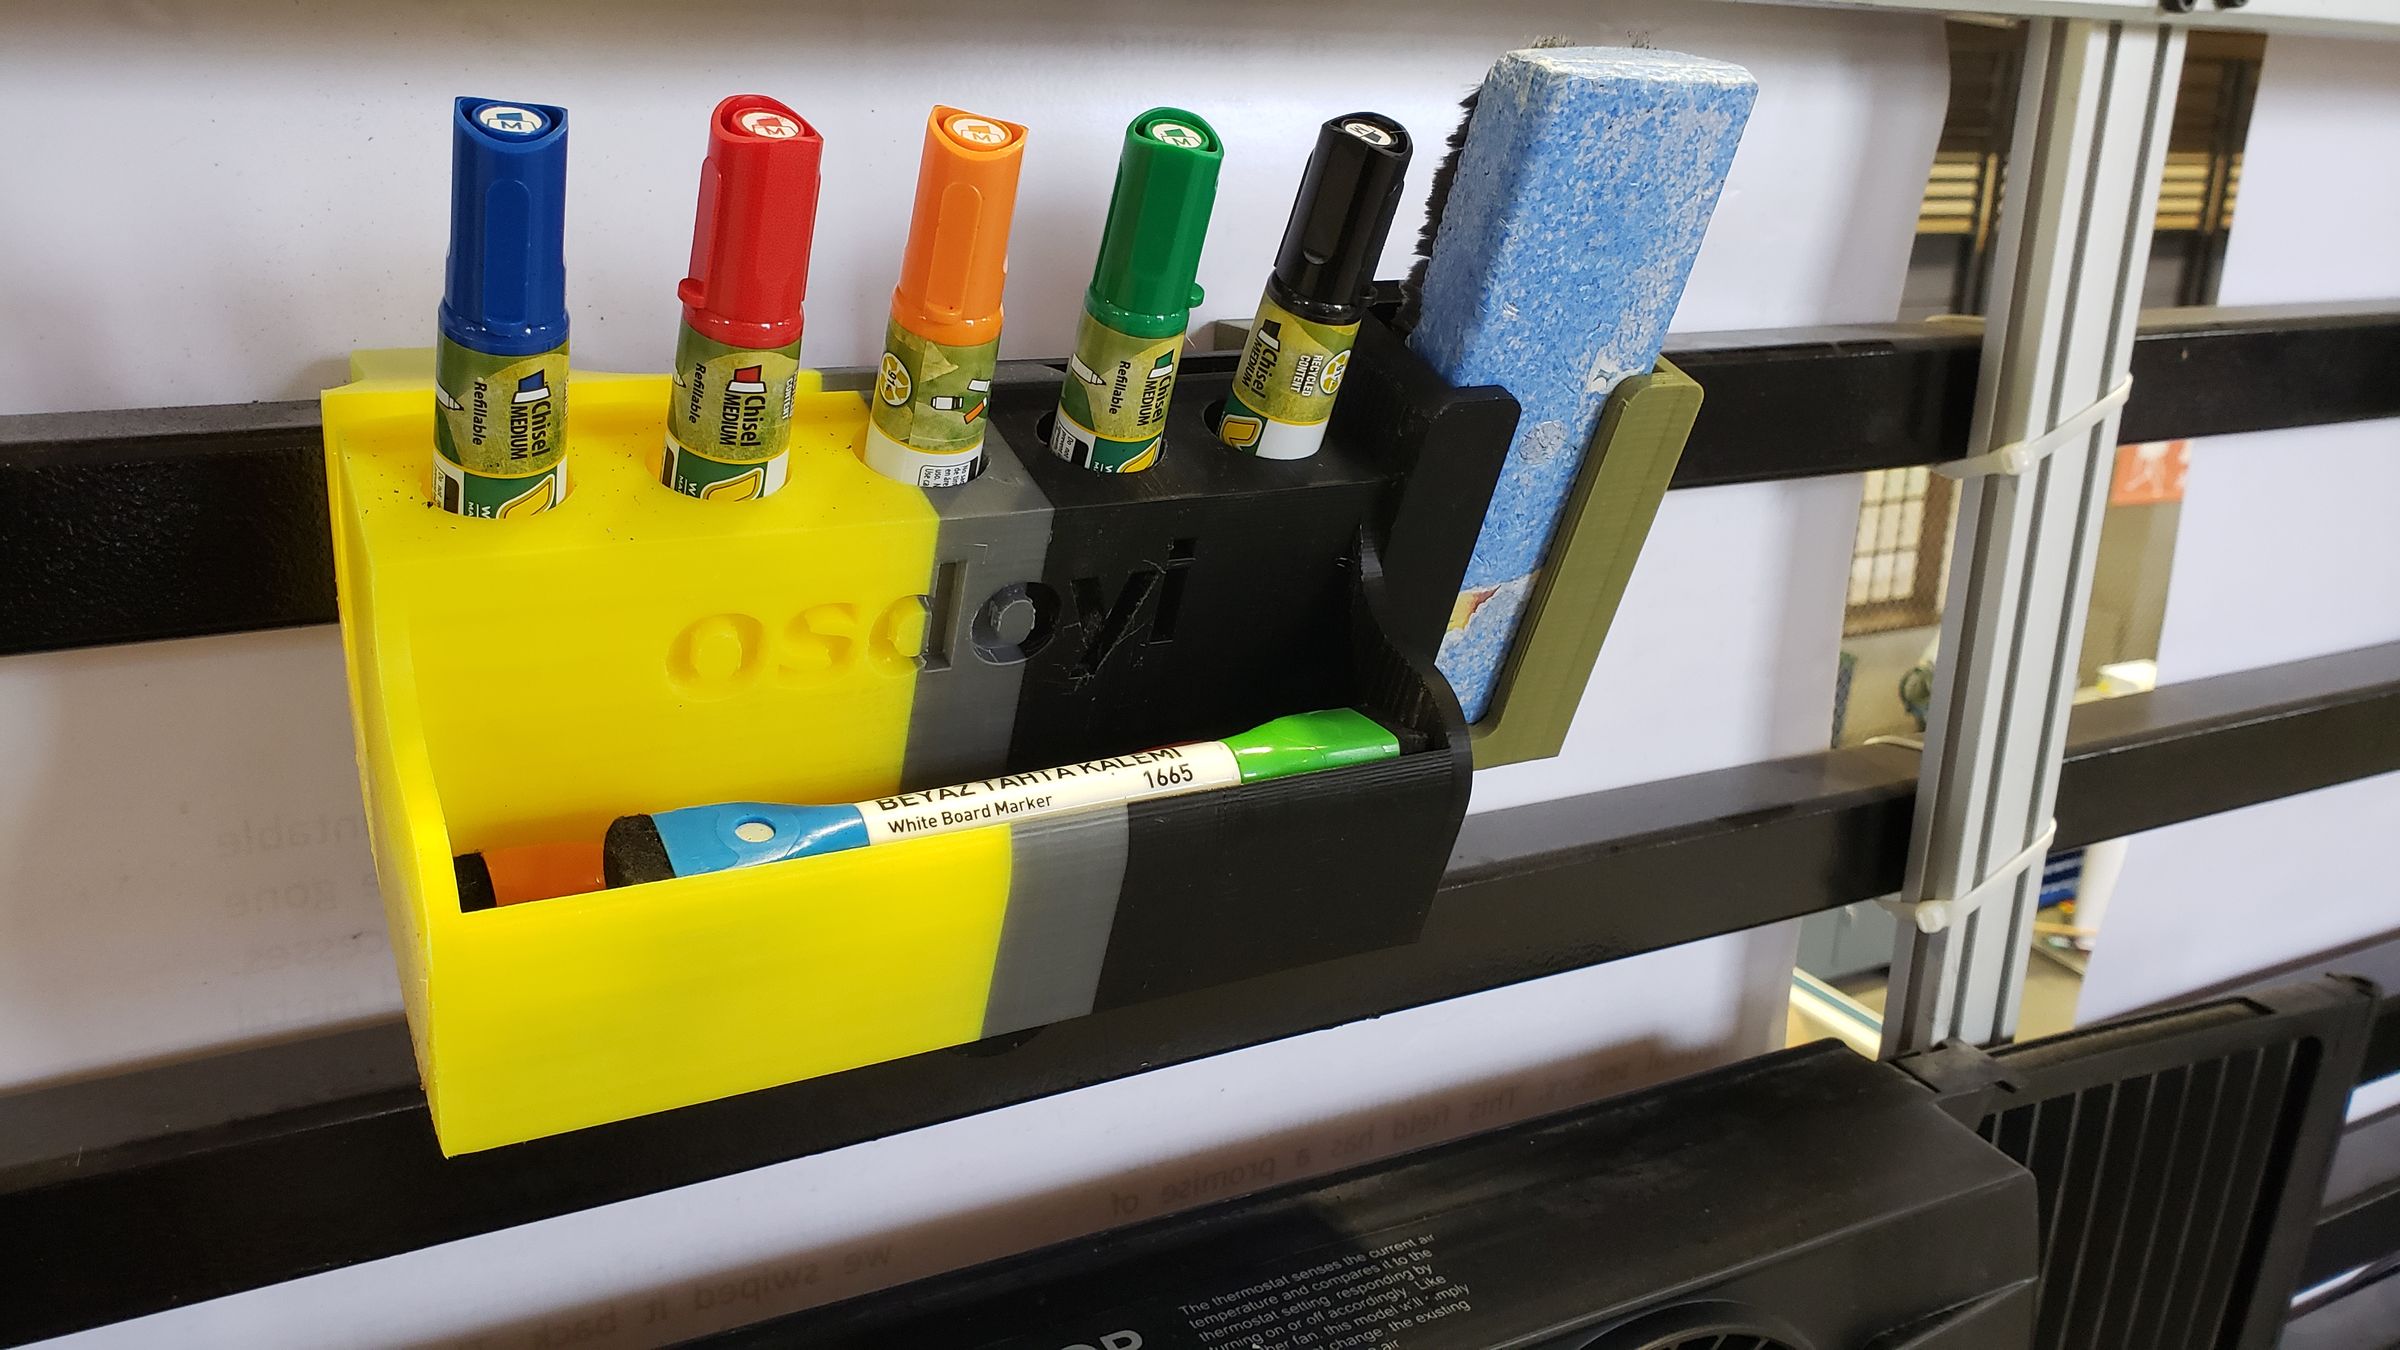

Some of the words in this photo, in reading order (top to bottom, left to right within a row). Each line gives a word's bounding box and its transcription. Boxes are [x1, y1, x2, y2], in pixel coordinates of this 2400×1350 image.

[500, 120, 523, 130] M
[764, 126, 786, 136] M
[972, 133, 991, 142] M
[1172, 137, 1192, 147] M
[1108, 361, 1131, 415] Refillable
[1241, 340, 1263, 388] MEDIUM
[1251, 348, 1280, 399] Chisel
[1291, 354, 1310, 393] CONTENT
[1301, 353, 1324, 397] RECYCLED
[472, 381, 488, 446] Refillable
[689, 363, 707, 424] Refillable
[1137, 380, 1157, 427] MEDIUM
[1151, 375, 1171, 424] Chisel
[510, 406, 528, 460] MEDIUM
[532, 401, 552, 458] Chisel
[719, 393, 741, 446] MEDIUM
[740, 395, 766, 447] Chisel
[876, 784, 976, 812] BEYAZ
[984, 767, 1076, 791] TAHTA
[1143, 763, 1194, 789] 1665
[888, 816, 938, 834] White
[942, 804, 991, 826] Board
[995, 794, 1053, 815] Marker
[1178, 1302, 1210, 1316] The
[1211, 1275, 1290, 1306] thermostat
[1291, 1261, 1342, 1282] senses
[1342, 1254, 1367, 1266] the
[1368, 1238, 1417, 1258] current
[1418, 1233, 1436, 1245] air
[1188, 1295, 1279, 1329] temperature
[1280, 1285, 1310, 1301] and
[1311, 1264, 1381, 1291] compares
[1381, 1259, 1393, 1270] it
[1392, 1256, 1408, 1267] to
[1408, 1249, 1433, 1262] the
[1198, 1310, 1280, 1342] thermostat
[1336, 1269, 1415, 1300] responding
[1412, 1263, 1433, 1276] by
[1265, 1326, 1285, 1338] on
[1287, 1319, 1302, 1331] or
[1306, 1310, 1325, 1325] off
[1414, 1275, 1447, 1291] Like
[1323, 1320, 1352, 1336] this
[1353, 1304, 1399, 1326] model
[1329, 1328, 1384, 1350] change
[1388, 1318, 1414, 1332] the
[1415, 1300, 1472, 1324] existing
